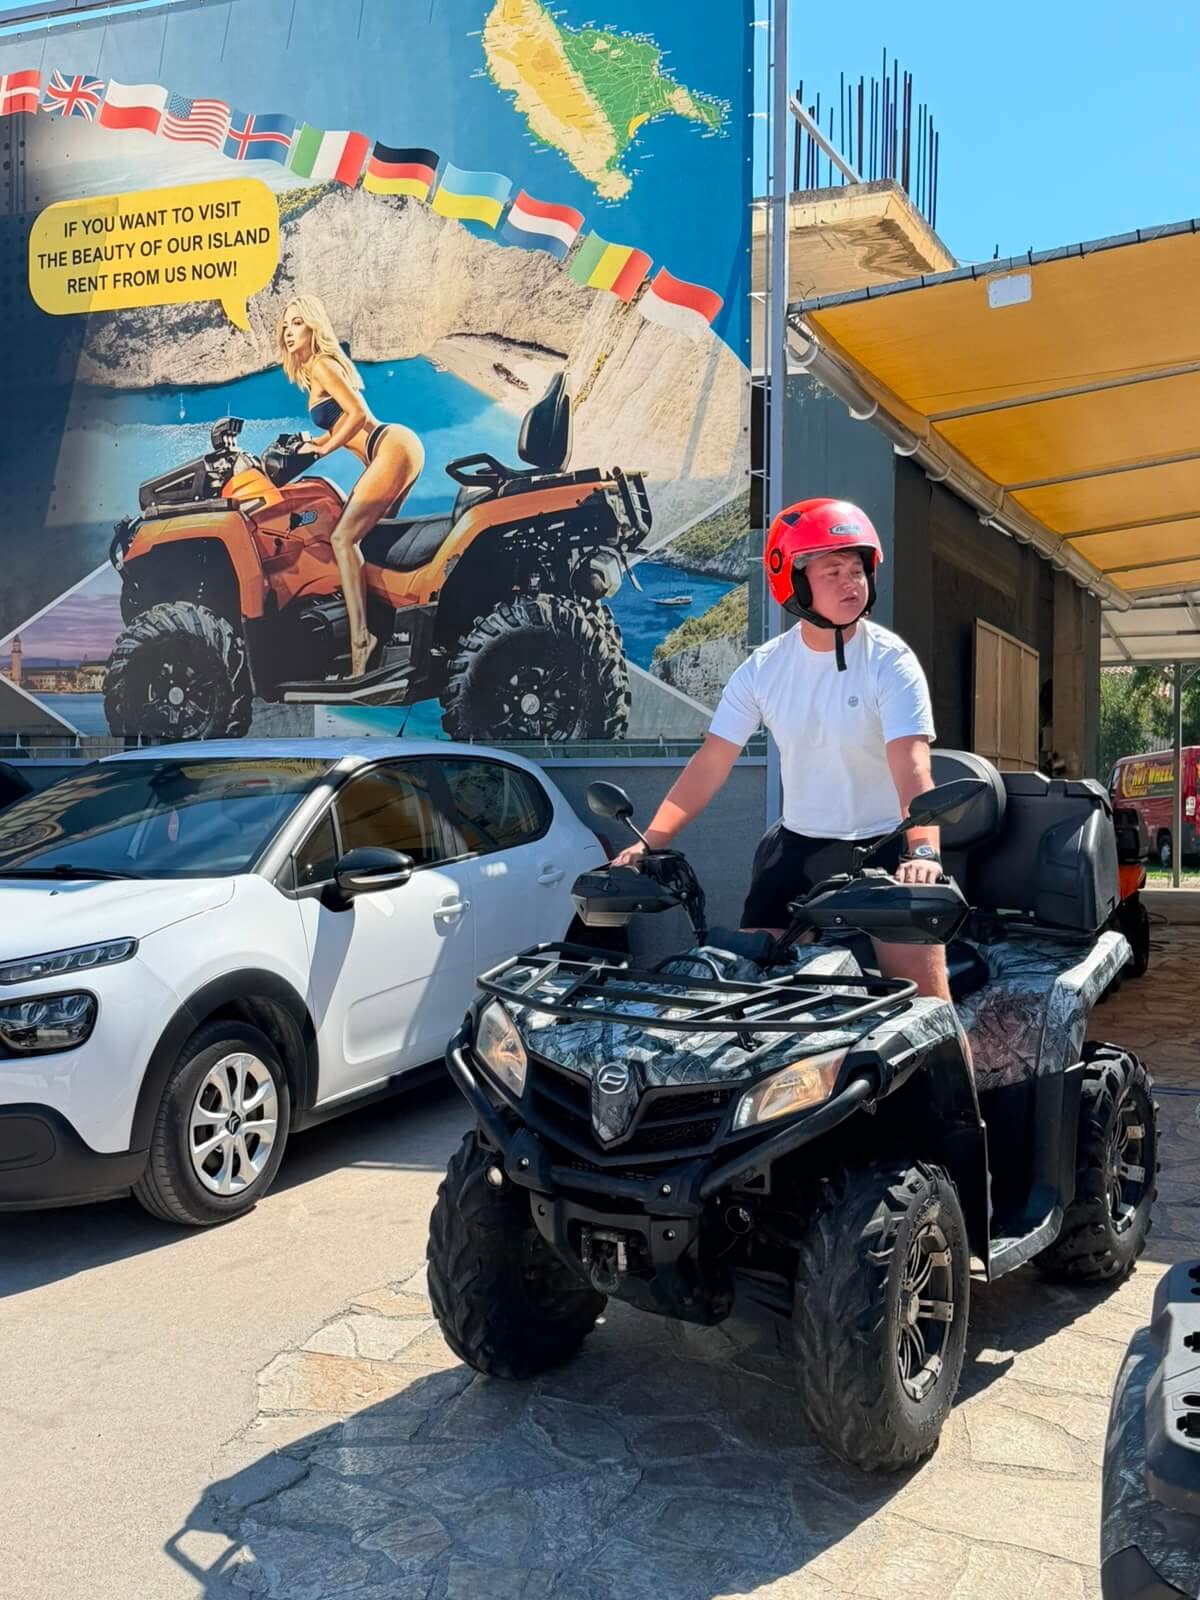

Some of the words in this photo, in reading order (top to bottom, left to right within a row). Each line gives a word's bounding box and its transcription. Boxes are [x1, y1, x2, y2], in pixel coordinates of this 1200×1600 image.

[64, 221, 77, 238] IF
[82, 216, 115, 235] YOU
[120, 210, 168, 229] WANT
[172, 206, 194, 224] TO
[198, 200, 241, 221] VISIT
[37, 250, 67, 270] THE
[71, 243, 135, 265] BEAUTY
[140, 240, 163, 257] OF
[167, 235, 203, 254] OUR
[208, 227, 271, 249] ISLAND
[67, 275, 109, 295] RENT
[113, 269, 160, 289] FROM
[165, 265, 187, 283] US
[191, 261, 237, 280] NOW!
